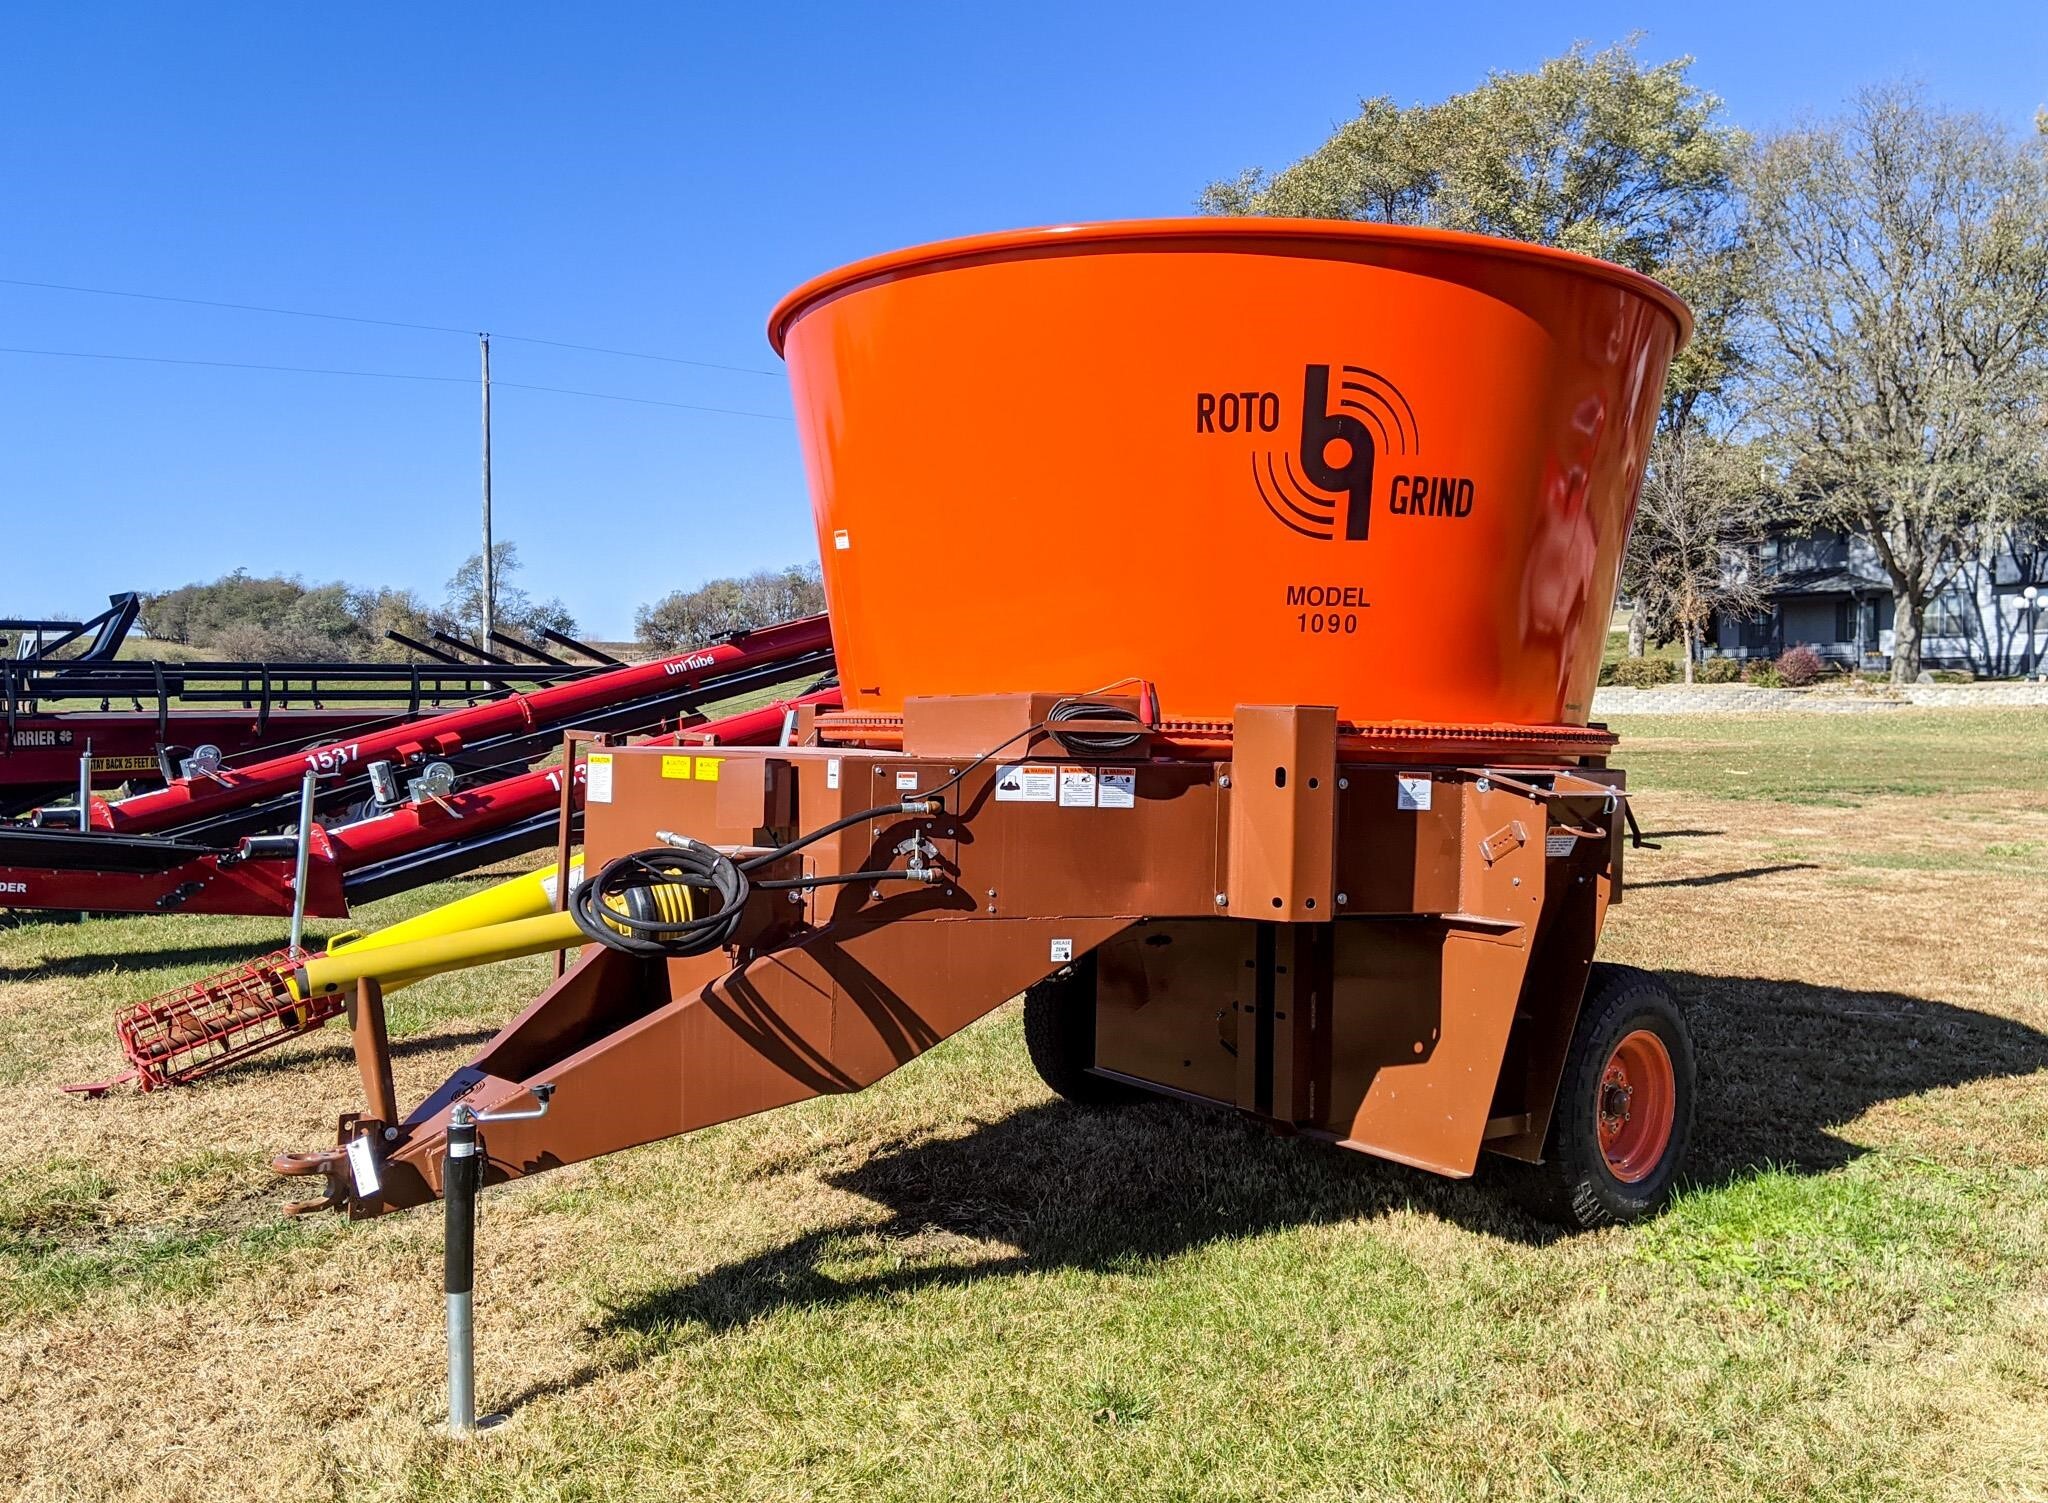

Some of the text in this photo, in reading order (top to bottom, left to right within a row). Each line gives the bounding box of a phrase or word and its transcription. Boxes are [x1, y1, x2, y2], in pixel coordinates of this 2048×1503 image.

[1196, 392, 1280, 433] ROTO
[1389, 474, 1475, 518] GRIND
[1286, 585, 1371, 607] MODEL
[1297, 613, 1358, 634] 1090
[106, 758, 123, 769] BACK
[124, 758, 133, 769] 25
[134, 757, 149, 768] FEET
[305, 744, 358, 771] 1537
[0, 882, 27, 893] DER
